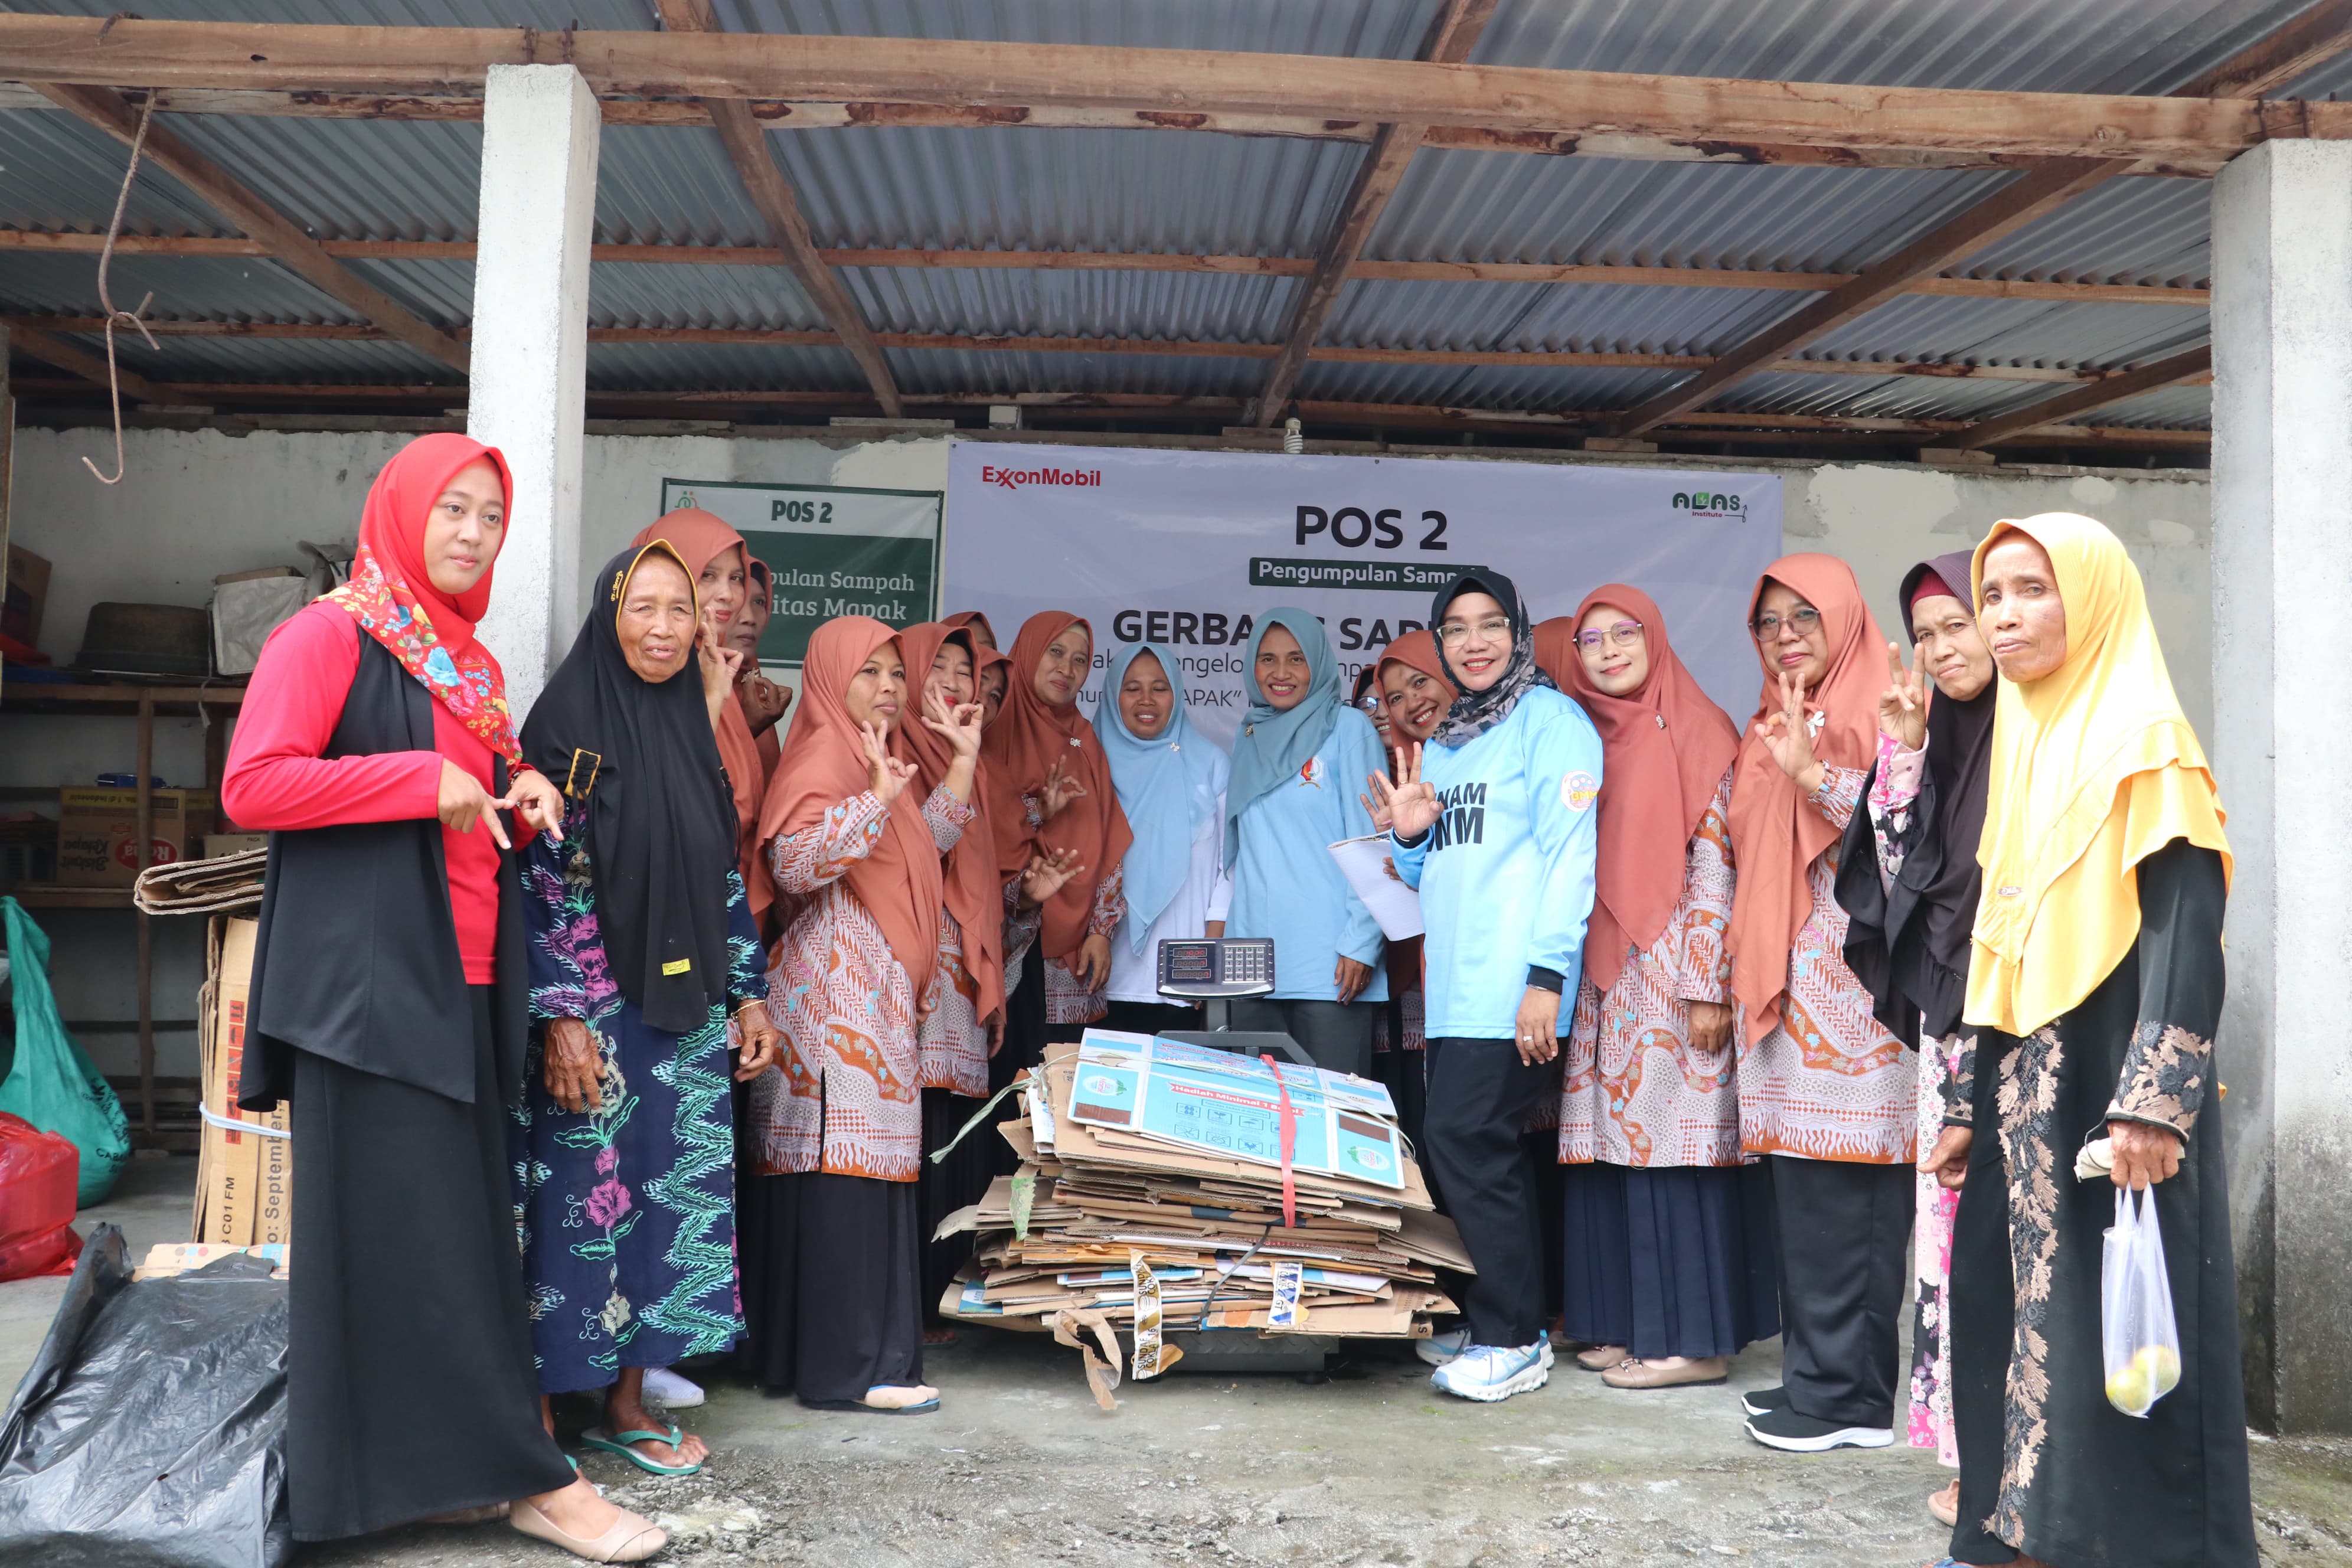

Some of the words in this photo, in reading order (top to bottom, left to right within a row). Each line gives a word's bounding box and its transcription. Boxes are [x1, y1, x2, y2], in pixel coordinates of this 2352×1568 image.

[982, 466, 1101, 489] ExxonMobil
[771, 500, 814, 522] POS
[819, 502, 832, 524] 2
[1296, 505, 1403, 549] POS
[1419, 510, 1448, 550] 2
[830, 571, 915, 594] Sampah
[1259, 561, 1397, 585] Pengumpulan
[1403, 566, 1458, 584] Samp
[1435, 782, 1488, 811] NAM
[1175, 1084, 1214, 1097] Hadiah
[1216, 1093, 1260, 1106] Minimal
[224, 1177, 235, 1200] FM
[222, 1205, 233, 1234] C01
[1148, 1328, 1157, 1337] 16
